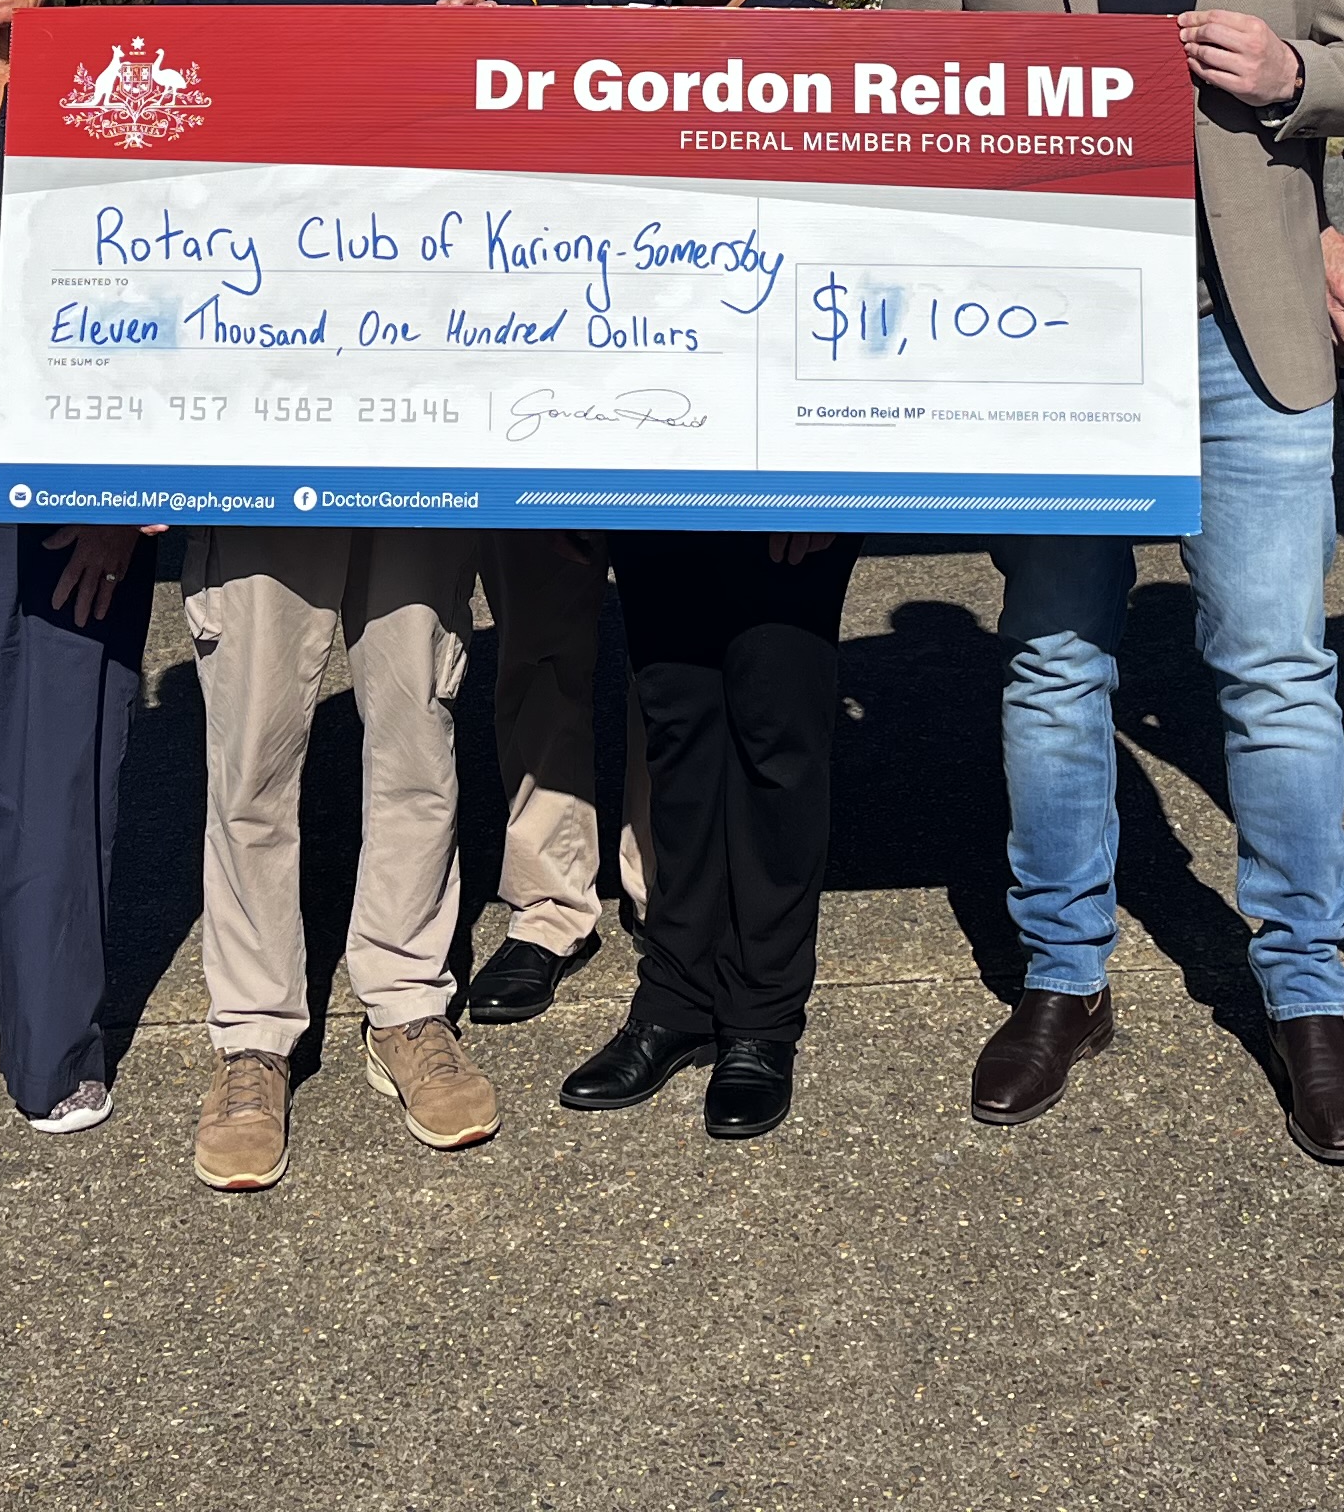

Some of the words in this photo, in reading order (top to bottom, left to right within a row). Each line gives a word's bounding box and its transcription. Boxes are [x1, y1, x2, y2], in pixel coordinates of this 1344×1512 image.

[475, 59, 555, 112] Dr
[573, 58, 832, 115] Gordon
[854, 61, 1006, 117] Reid
[1027, 65, 1134, 118] MP
[680, 130, 794, 151] FEDERAL
[803, 131, 912, 153] MEMBER
[921, 133, 971, 154] FOR
[980, 134, 1134, 157] ROBERTSON
[96, 207, 261, 296] Rotary
[298, 212, 399, 261] Club
[421, 211, 463, 262] of
[486, 210, 785, 314] Kariong-Somersby
[51, 277, 112, 286] PRESENTED
[115, 278, 129, 286] TO
[51, 302, 159, 345] Eleven
[358, 311, 421, 346] One
[446, 307, 568, 346] Hundred
[588, 314, 699, 351] Dollars
[47, 357, 67, 366] THE
[70, 357, 93, 366] SUM
[95, 358, 110, 366] OF
[45, 395, 144, 421] 76324
[169, 396, 228, 421] 957
[254, 397, 334, 422] 4582
[358, 397, 459, 423] 23146
[797, 406, 813, 418] Dr
[816, 405, 866, 419] Gordon
[870, 405, 900, 419] Reid
[904, 407, 926, 419] MP
[931, 409, 984, 421] FEDERAL
[988, 410, 1039, 422] MEMBER
[1042, 411, 1066, 422] FOR
[1070, 411, 1141, 423] ROBERTSON
[35, 489, 275, 512] Gordon.Reid.MP@aph.gov.au
[322, 490, 479, 509] DoctorGordonReid
